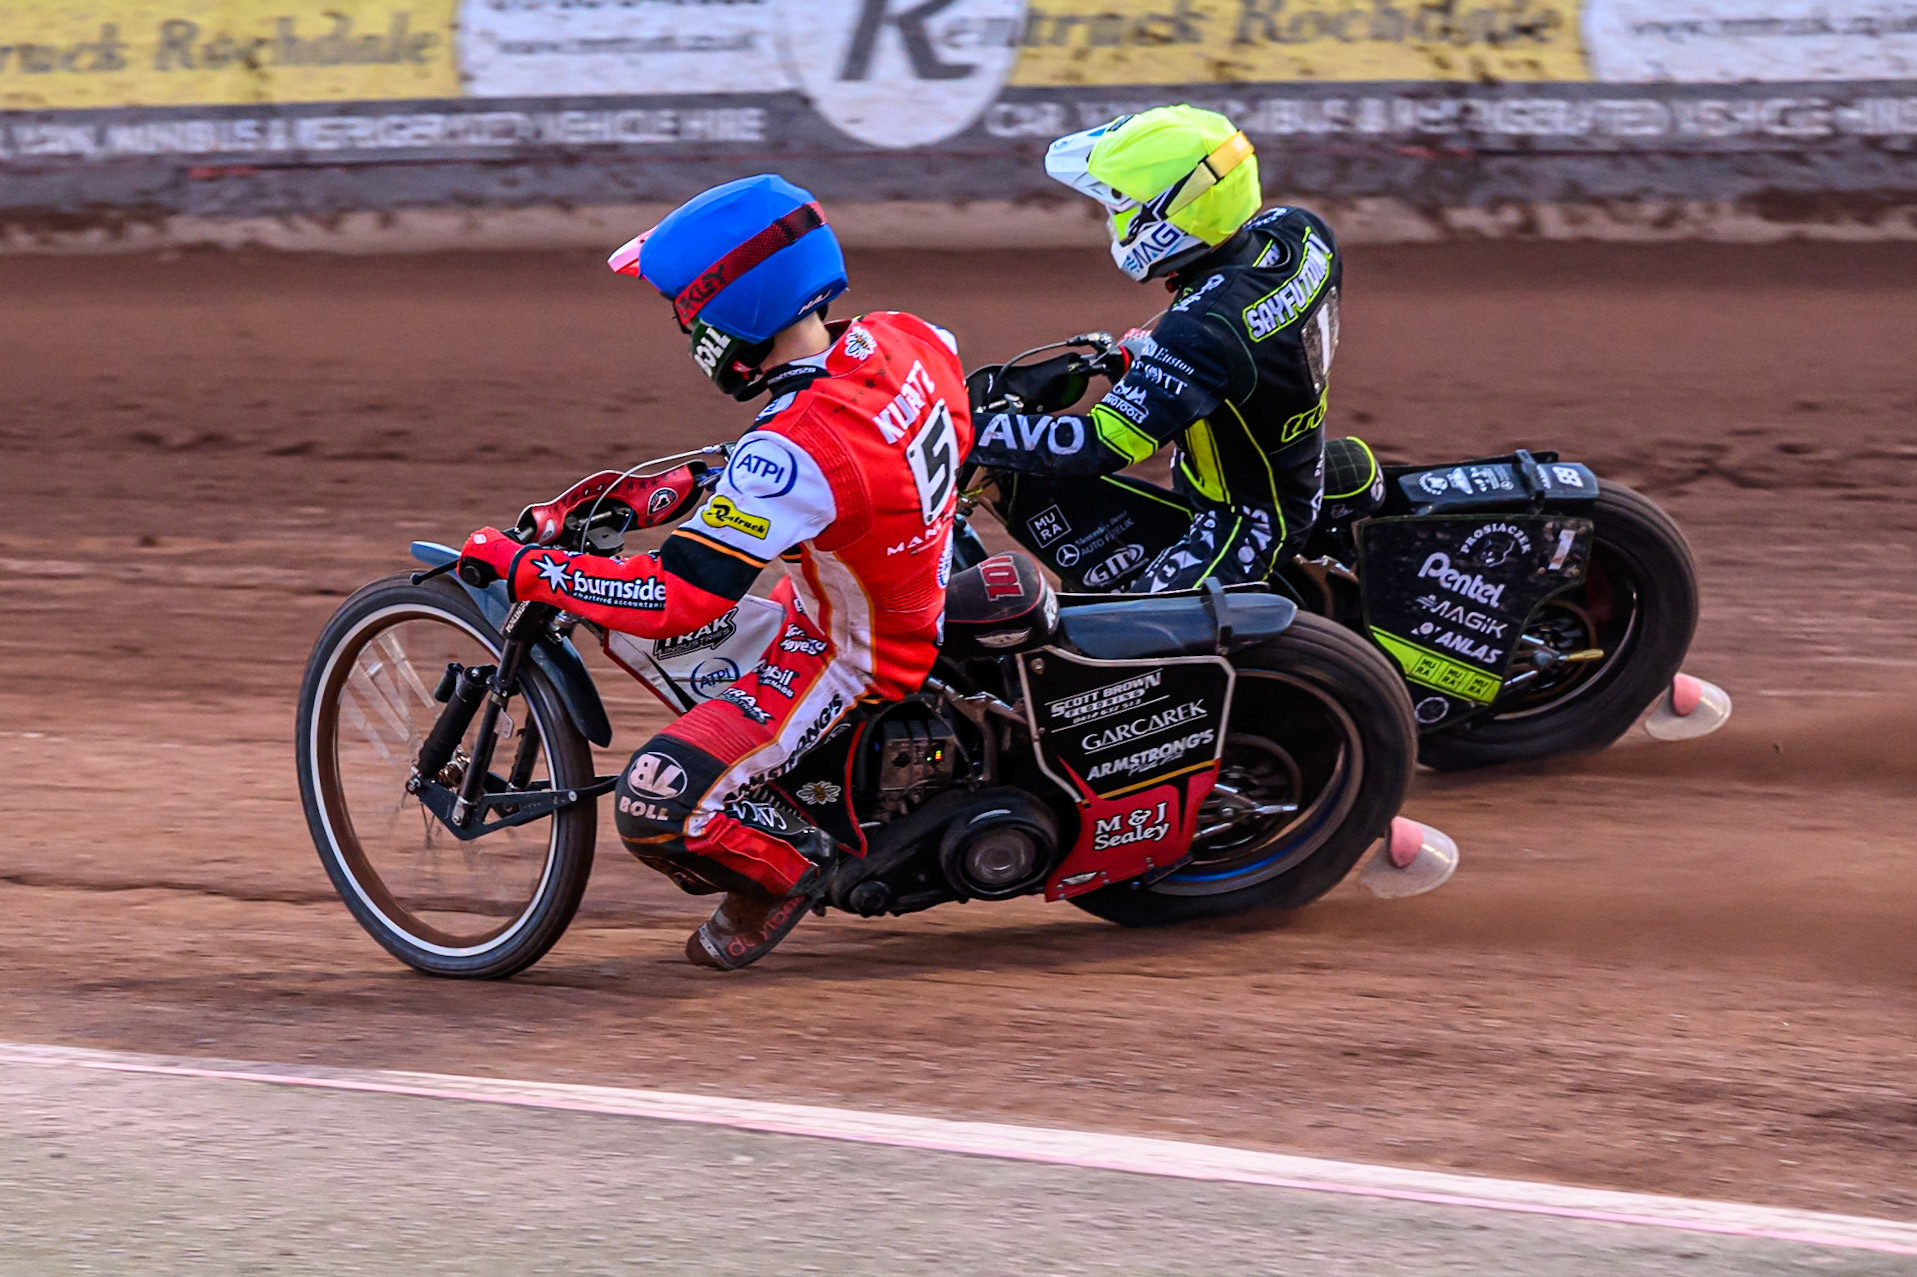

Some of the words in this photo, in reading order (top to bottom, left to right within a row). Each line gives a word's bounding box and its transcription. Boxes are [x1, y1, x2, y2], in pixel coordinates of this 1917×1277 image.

[978, 412, 1086, 456] AVO
[736, 453, 785, 484] ATPI
[919, 408, 952, 514] 5
[573, 571, 665, 601] burnside
[1417, 551, 1505, 608] Pentel
[1434, 631, 1503, 664] ANLAS
[1081, 698, 1208, 751] GARCAREK
[1086, 728, 1214, 781] ARMSTRONG'S
[618, 796, 670, 822] BOLL
[1095, 814, 1123, 835] M
[1127, 809, 1152, 827] &
[1153, 802, 1168, 825] J
[1094, 822, 1170, 850] Sealey
